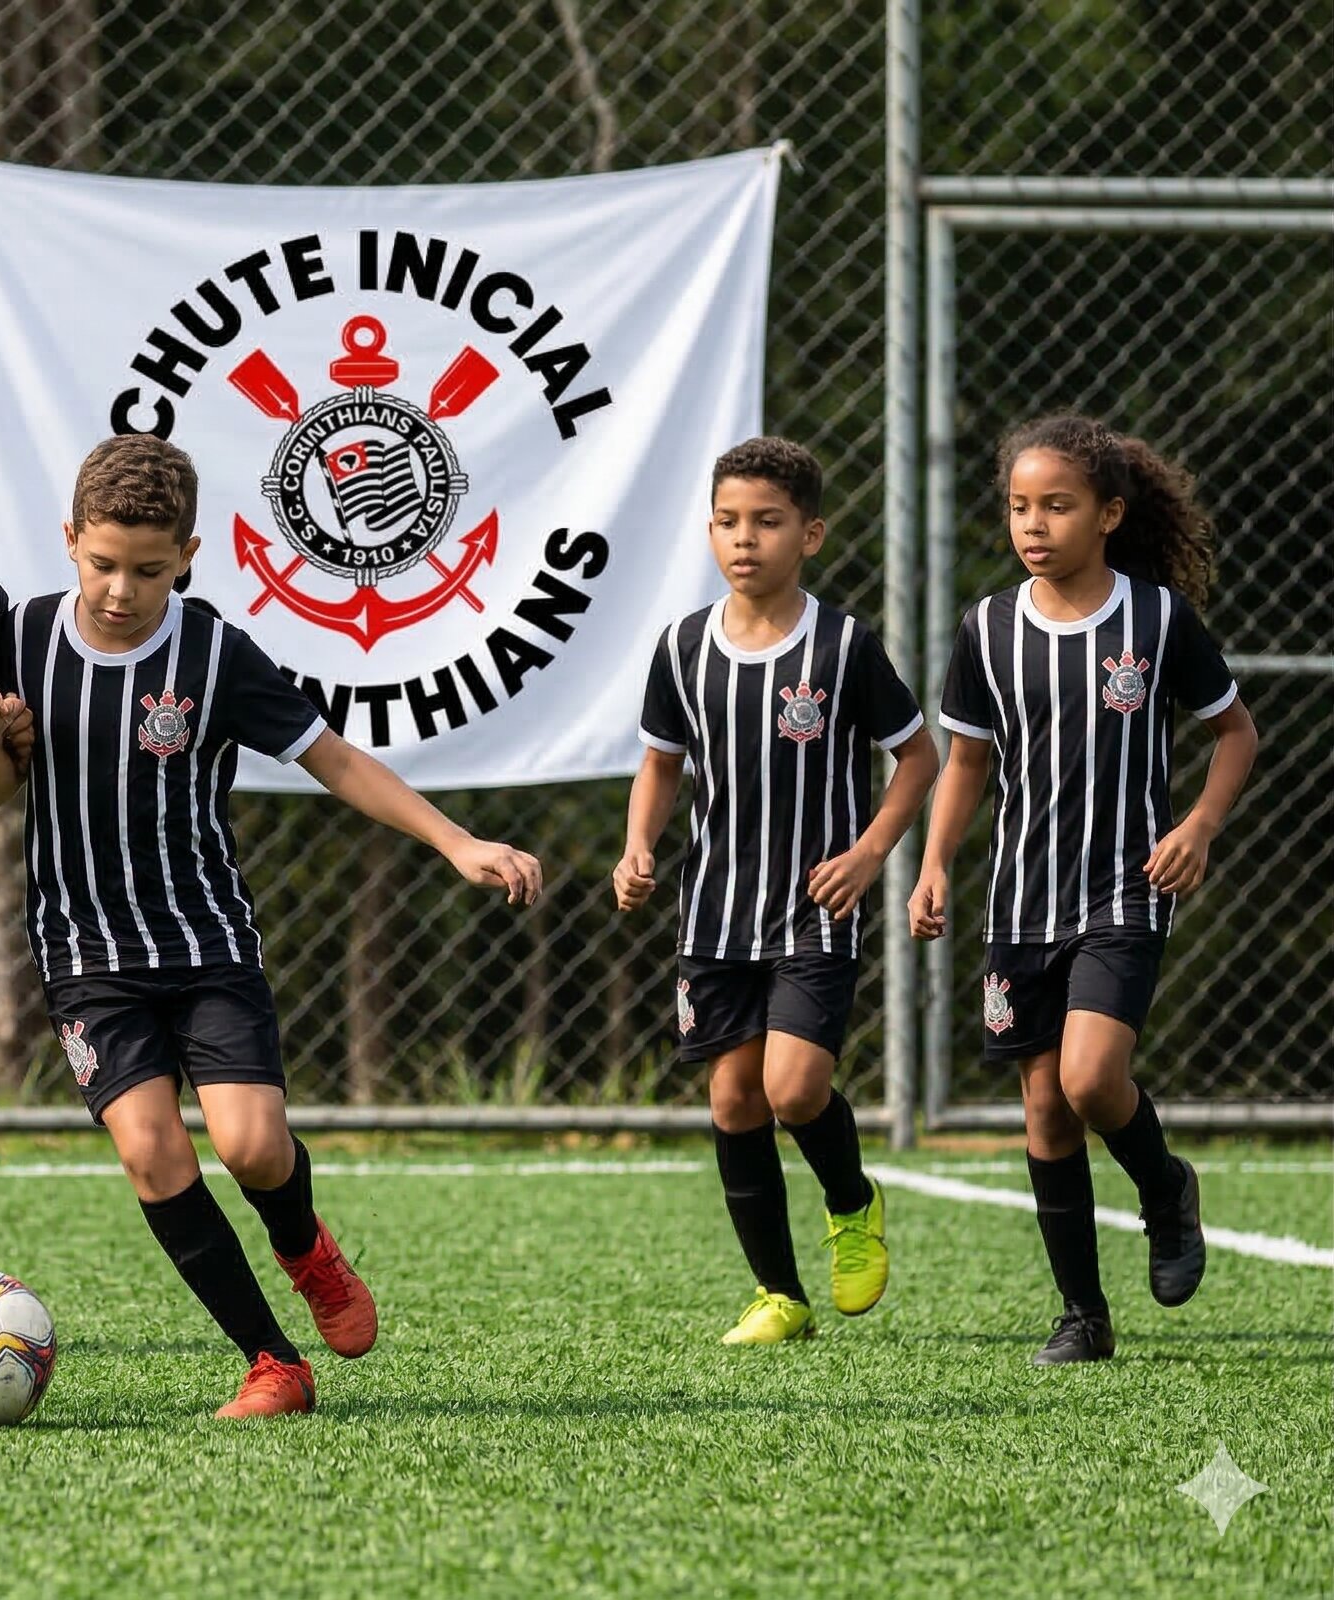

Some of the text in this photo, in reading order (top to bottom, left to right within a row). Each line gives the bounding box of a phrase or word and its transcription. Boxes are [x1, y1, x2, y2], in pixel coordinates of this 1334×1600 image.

[110, 229, 613, 441] CHUTE INICIAL
[283, 405, 414, 491] CORINTHIANS
[410, 433, 446, 539] PAULISTA
[342, 547, 395, 566] 1910
[174, 527, 610, 748] NTHIANS
